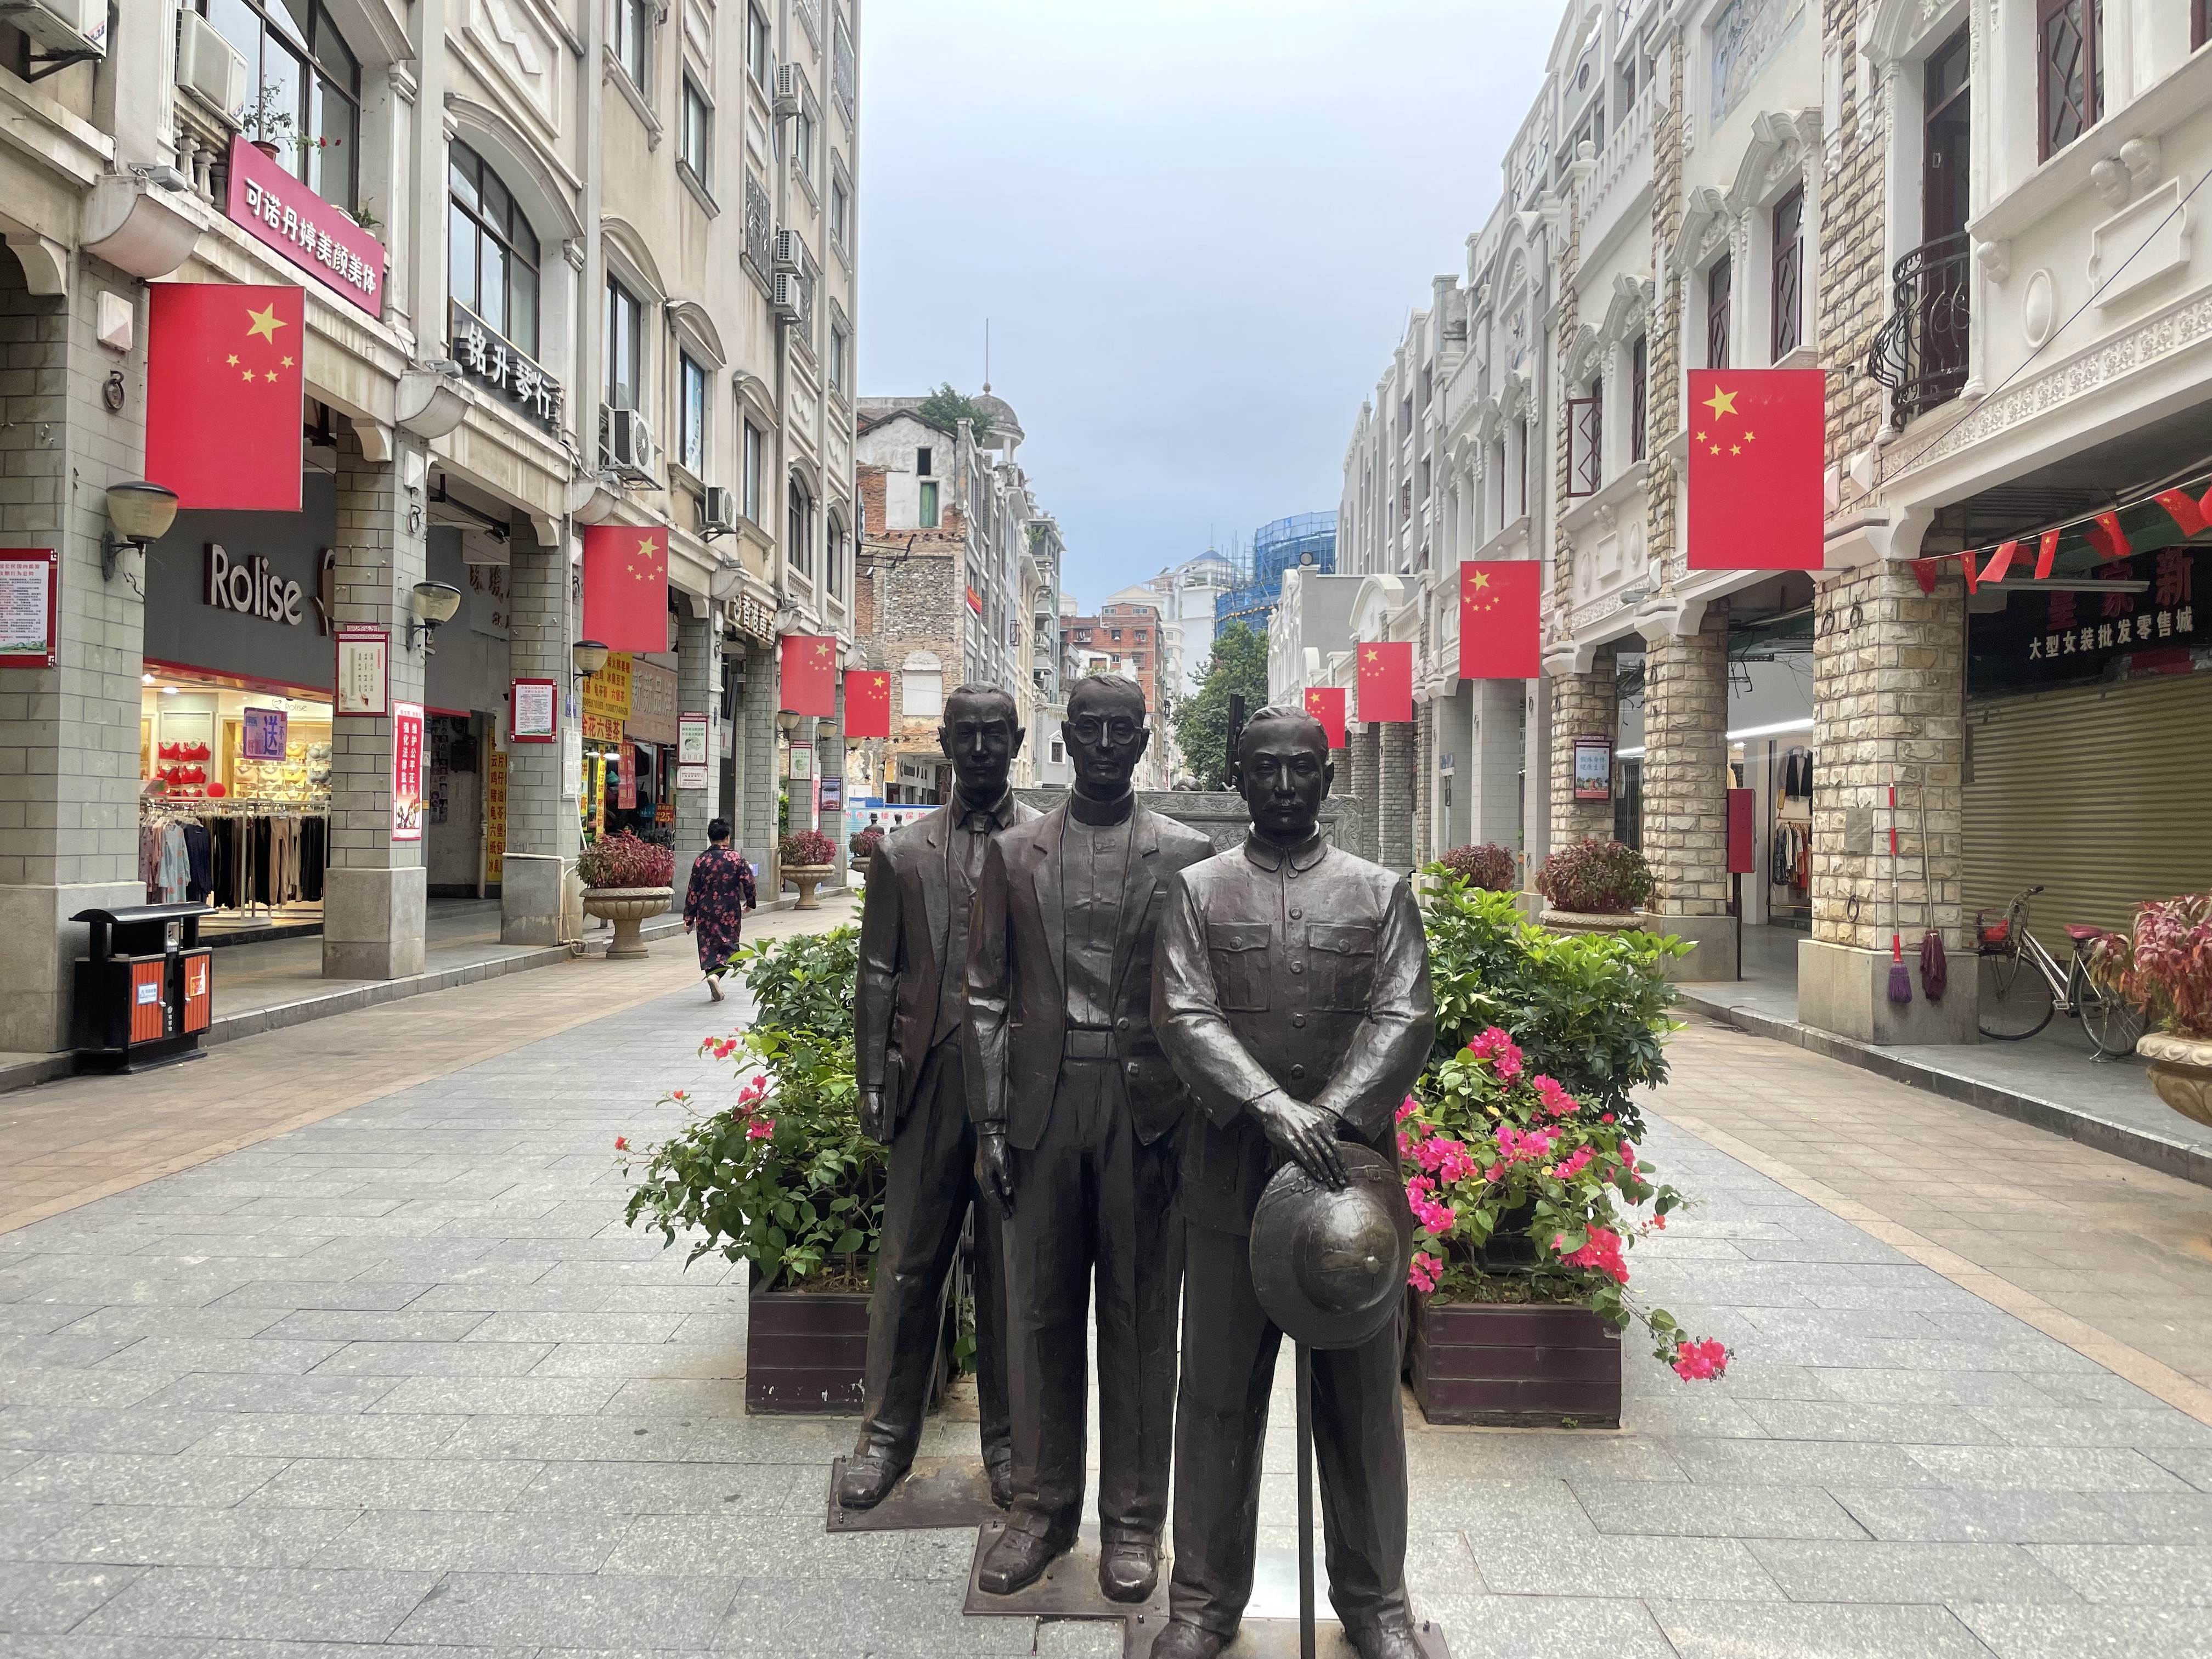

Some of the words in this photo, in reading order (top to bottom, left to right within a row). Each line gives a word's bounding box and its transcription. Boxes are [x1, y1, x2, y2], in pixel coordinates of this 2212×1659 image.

[245, 177, 376, 295] 可诺丹婷美颜美体
[469, 320, 551, 419] 铭升琴行
[211, 543, 302, 625] Rolise
[2029, 606, 2193, 661] 大型女装批发零售城
[263, 715, 278, 755] 送
[285, 703, 307, 712] Rolise
[400, 722, 409, 795] 强化法律监督
[409, 723, 418, 797] 维护公平正义
[659, 812, 670, 822] 25
[845, 811, 926, 820] 州市楼保护
